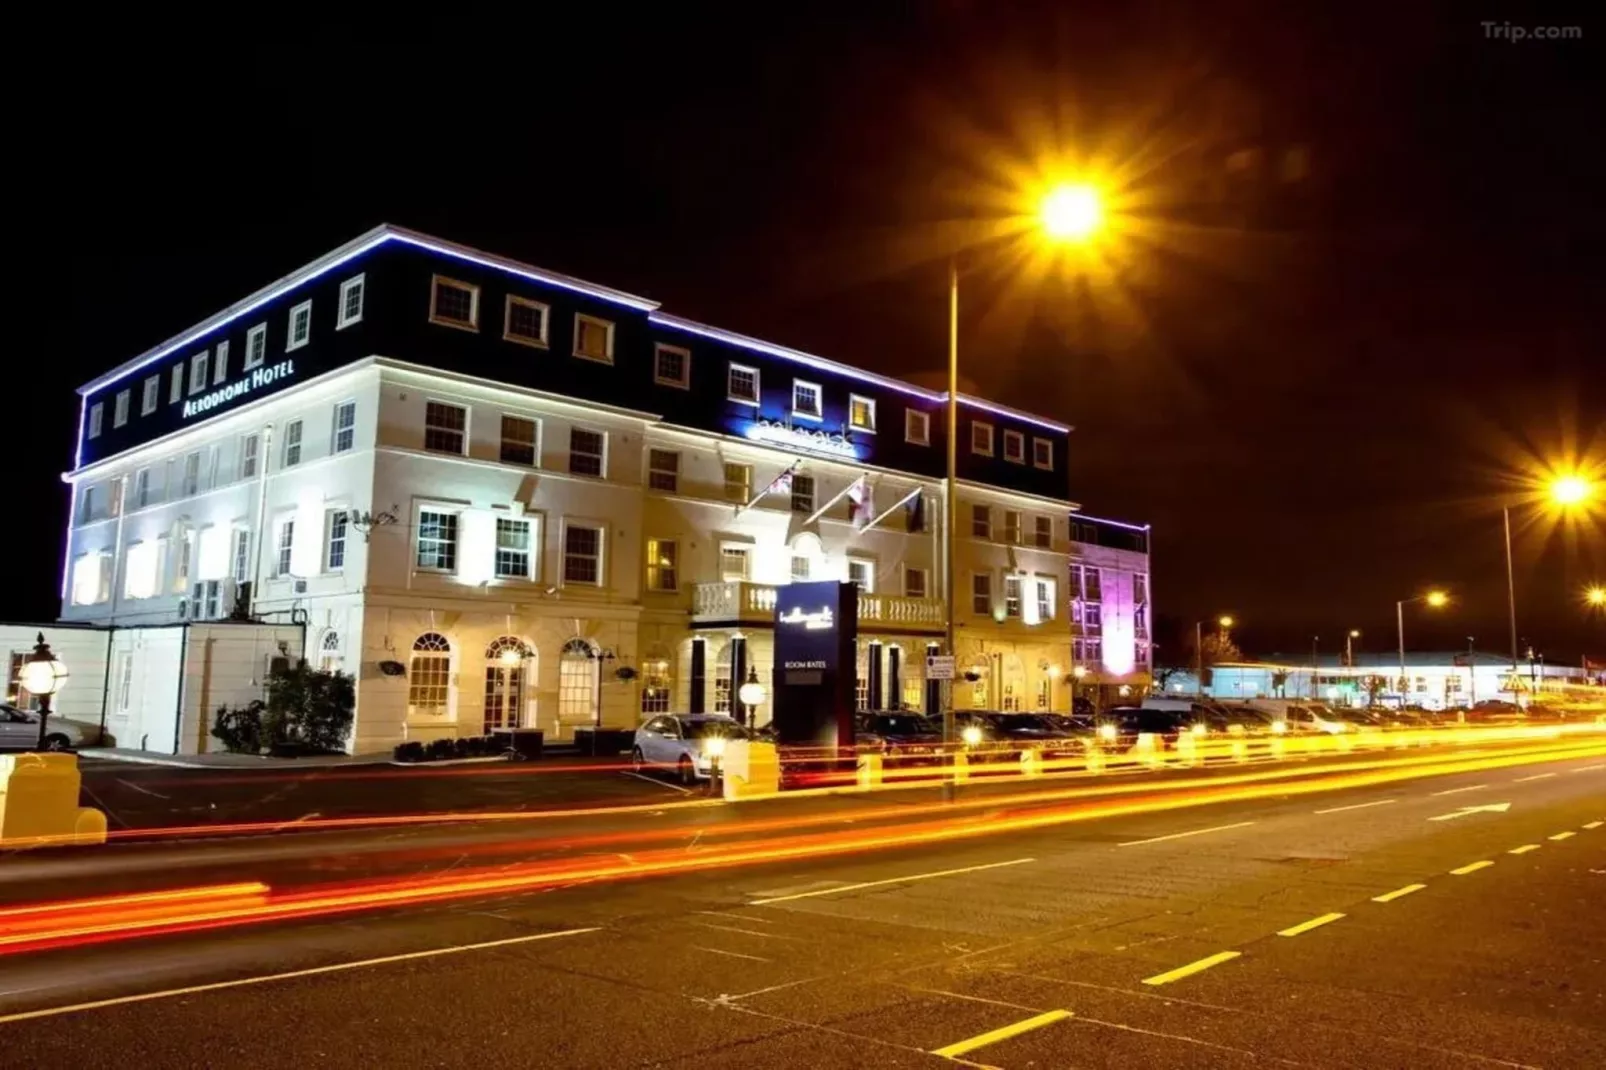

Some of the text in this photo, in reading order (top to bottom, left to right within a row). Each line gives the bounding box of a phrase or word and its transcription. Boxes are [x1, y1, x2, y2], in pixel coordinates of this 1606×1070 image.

[183, 359, 294, 418] AERODROME HOTEL
[785, 661, 805, 669] ROOM
